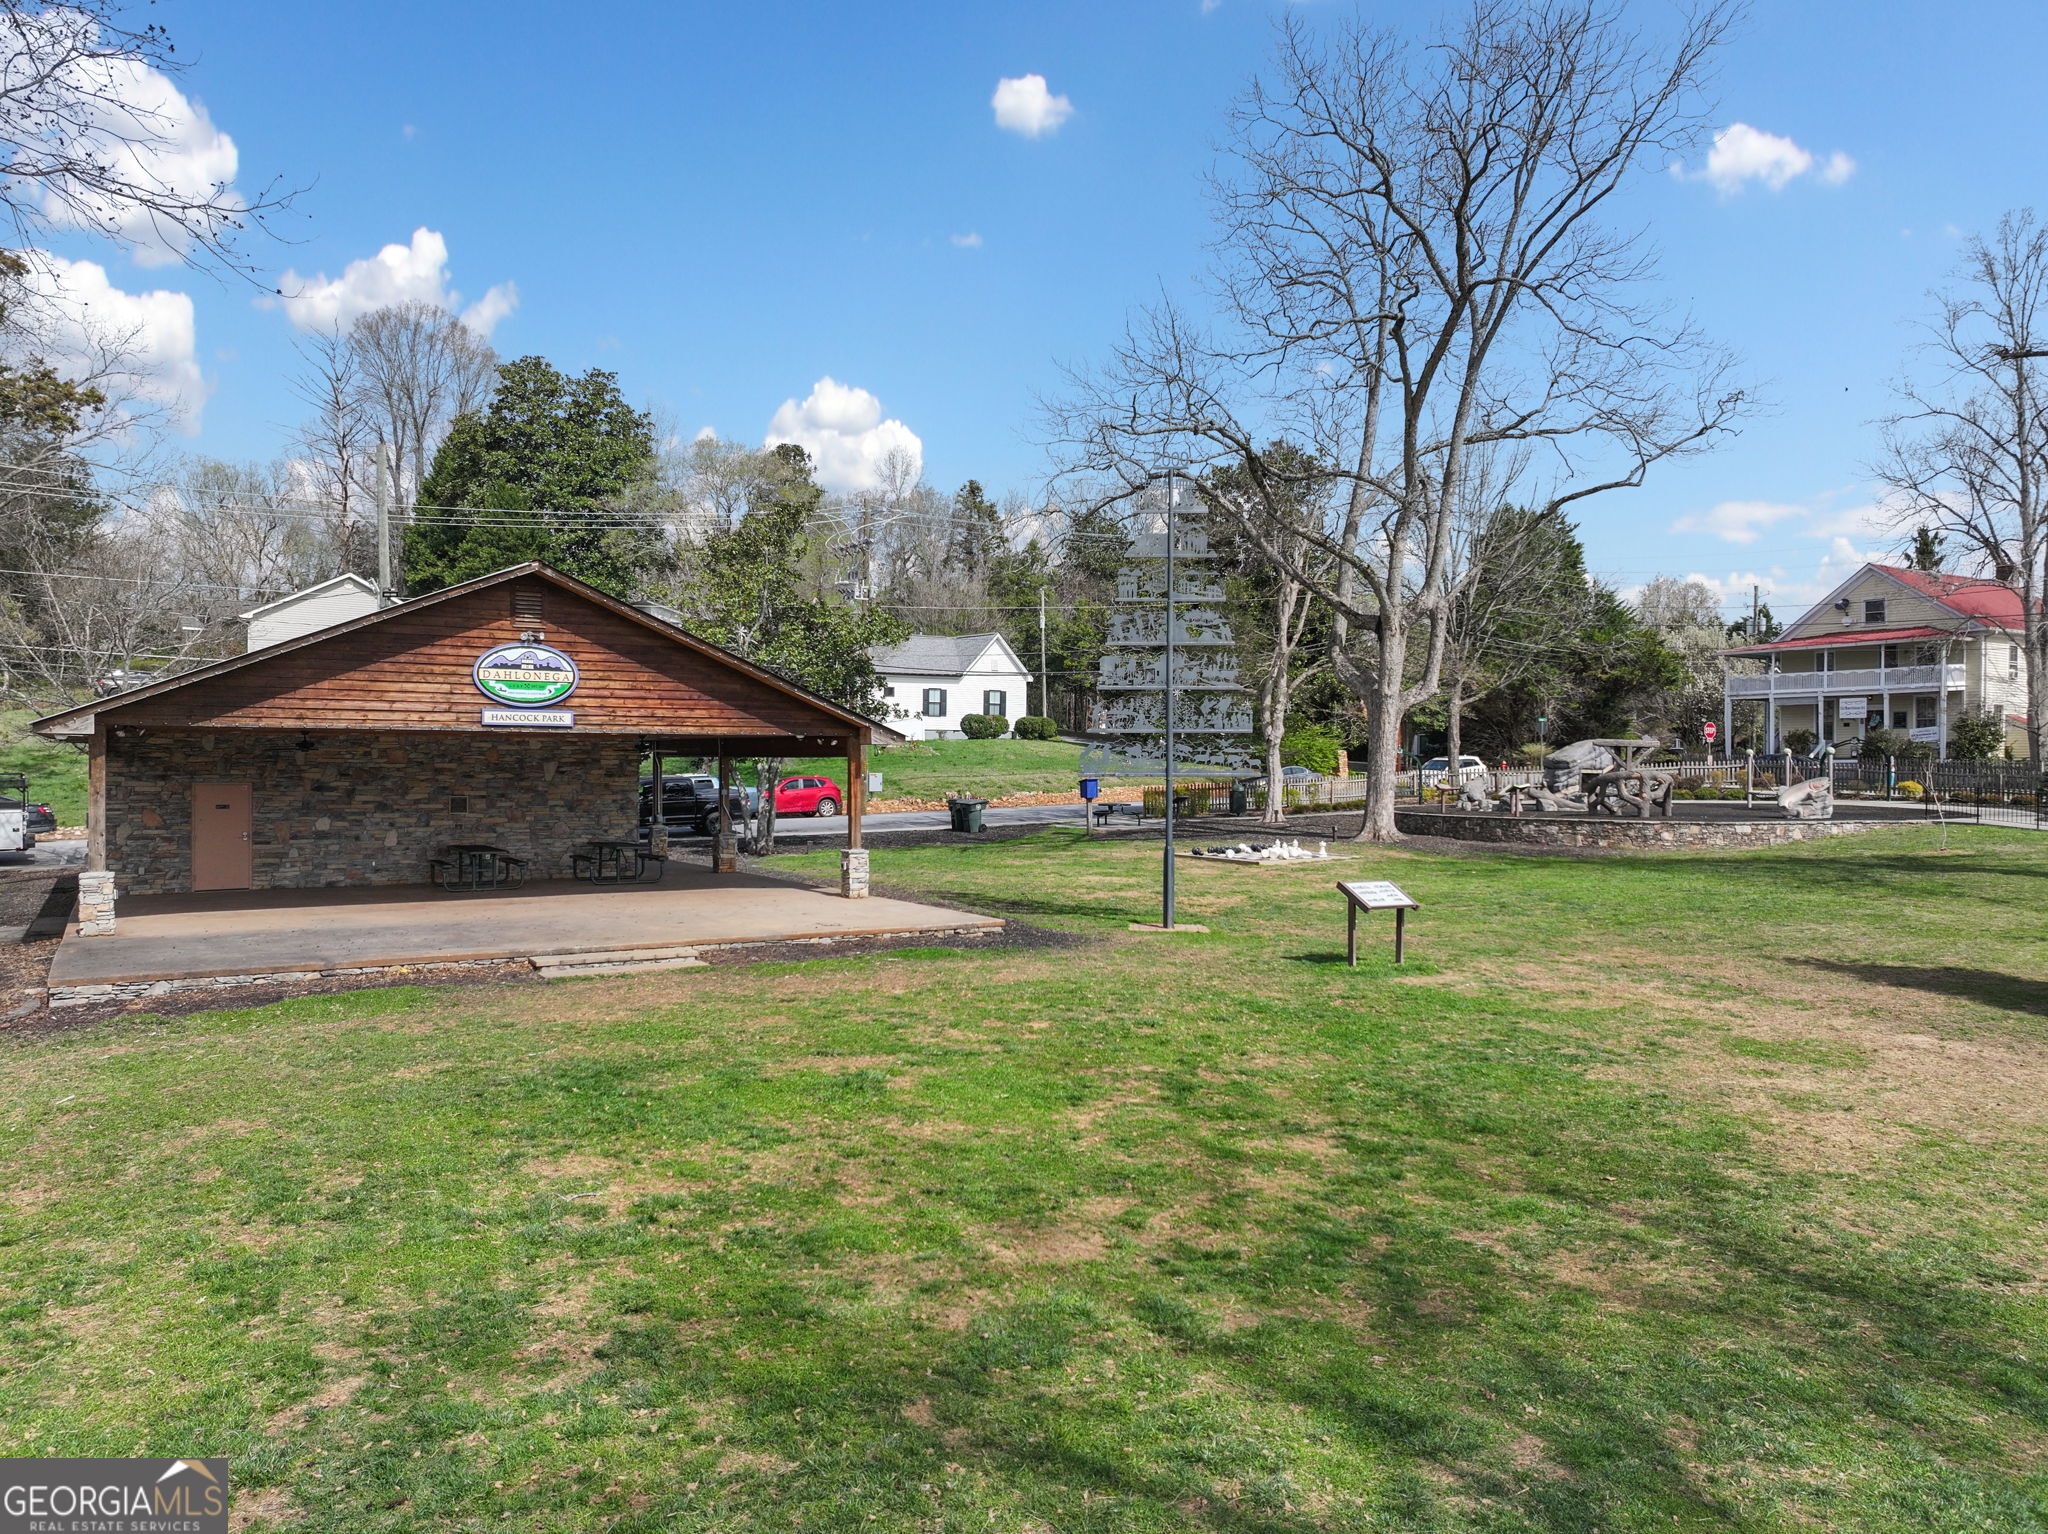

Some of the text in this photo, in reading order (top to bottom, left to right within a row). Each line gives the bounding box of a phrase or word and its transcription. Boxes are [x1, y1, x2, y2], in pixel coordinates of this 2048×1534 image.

[482, 670, 570, 682] DAHLONEGA
[491, 713, 565, 723] HANCOCK PARK
